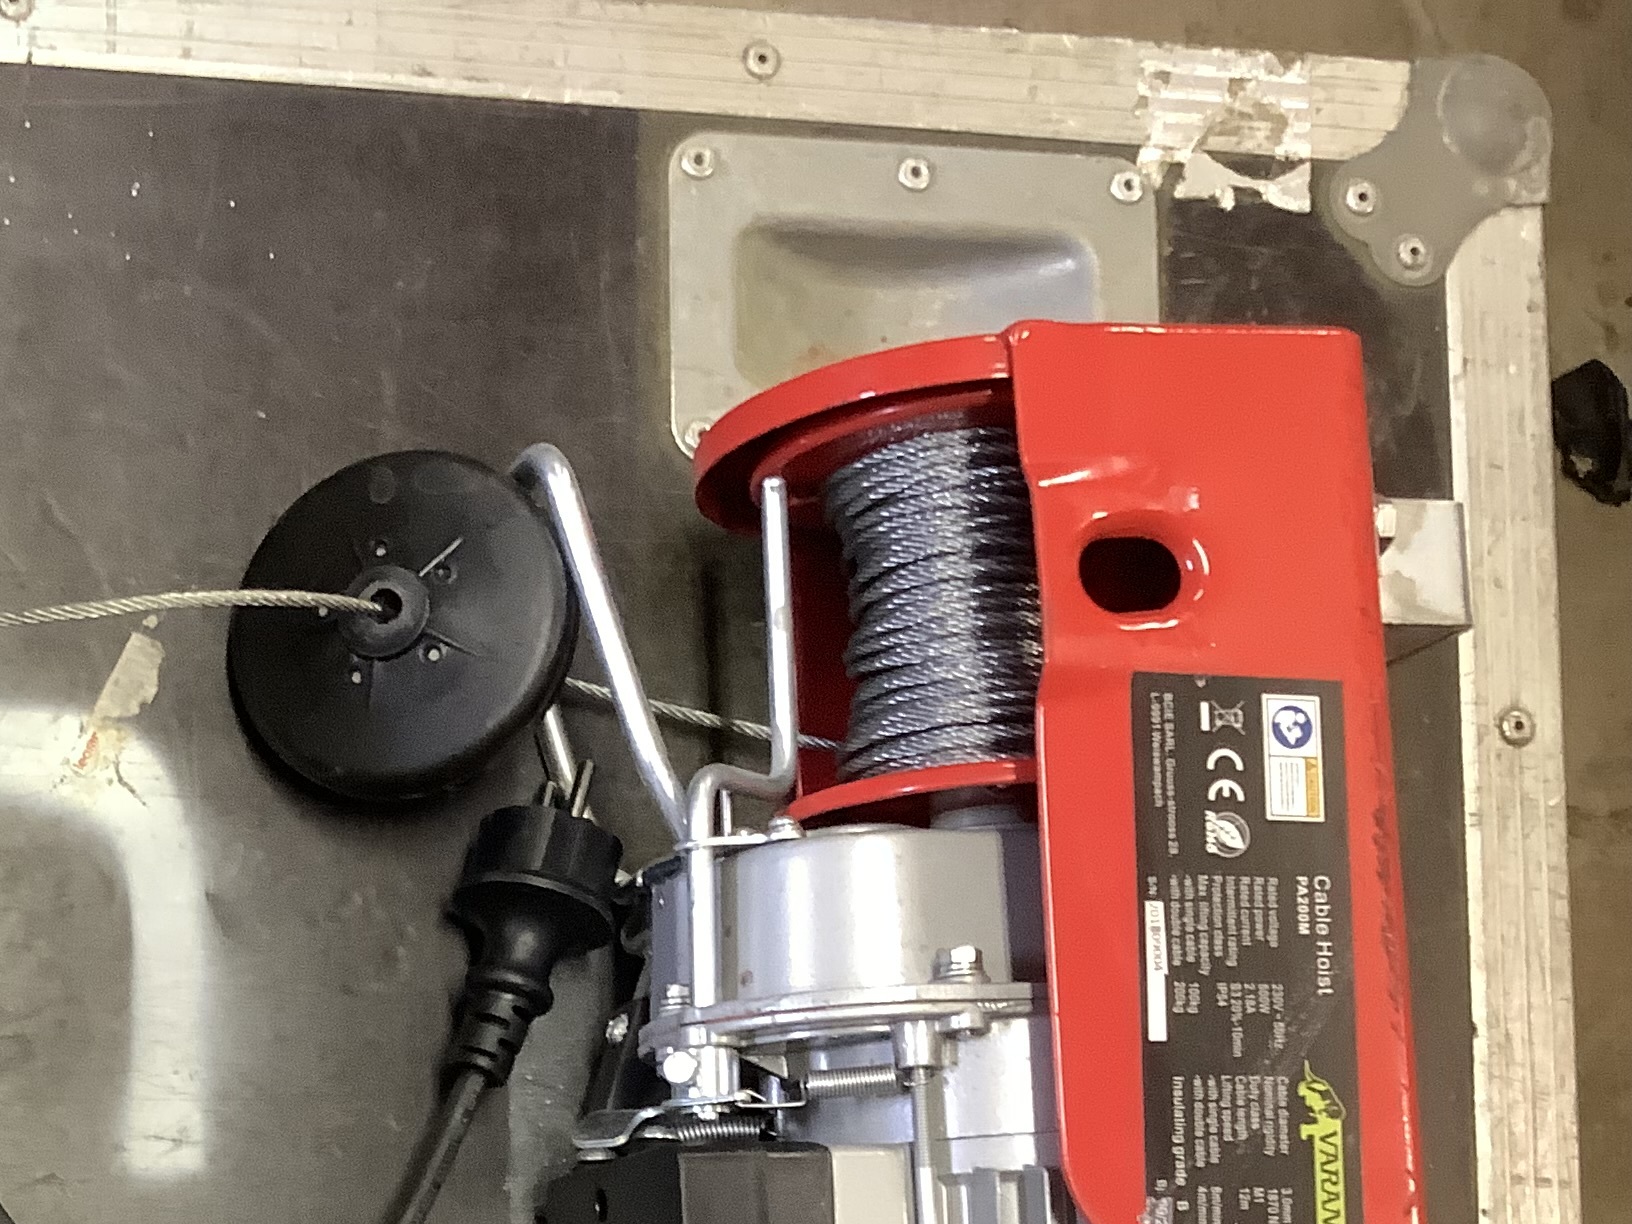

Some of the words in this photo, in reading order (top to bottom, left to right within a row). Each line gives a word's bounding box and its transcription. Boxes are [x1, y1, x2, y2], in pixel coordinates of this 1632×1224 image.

[1206, 748, 1245, 802] CE
[1211, 876, 1222, 927] Protection
[1226, 876, 1237, 934] Intermittent
[1240, 877, 1251, 907] Rated
[1253, 877, 1264, 907] Rated
[1267, 878, 1278, 908] Rated
[1296, 876, 1309, 934] PA200M
[1314, 876, 1332, 935] Cable
[1170, 901, 1181, 936] double
[1183, 902, 1195, 932] single
[1240, 909, 1251, 945] current
[1252, 909, 1264, 941] power
[1266, 910, 1278, 948] voltage
[1172, 938, 1182, 966] cable
[1186, 934, 1196, 962] cable
[1198, 933, 1211, 975] capacity
[1213, 930, 1223, 957] class
[1225, 936, 1237, 966] rating
[1316, 941, 1334, 995] Hoist
[1172, 981, 1186, 1013] 200kg
[1187, 983, 1200, 1013] 100kg
[1271, 984, 1284, 1011] 230V
[1220, 1075, 1232, 1107] Lifting
[1235, 1076, 1246, 1106] Cable
[1248, 1076, 1261, 1100] Duty
[1263, 1077, 1274, 1119] Nominal
[1277, 1077, 1289, 1106] Cable
[1172, 1077, 1187, 1143] Insulating
[1194, 1102, 1205, 1137] double
[1206, 1102, 1218, 1133] single
[1221, 1110, 1234, 1141] speed
[1235, 1108, 1248, 1140] length
[1250, 1102, 1261, 1129] class
[1263, 1121, 1275, 1156] rigidity
[1278, 1109, 1290, 1154] diameter
[1195, 1139, 1206, 1167] cable
[1209, 1135, 1220, 1163] cable
[1172, 1146, 1188, 1186] grade
[1176, 1201, 1189, 1211] B
[1238, 1188, 1249, 1210] 12m
[1253, 1188, 1264, 1202] M1
[1267, 1189, 1278, 1213] 1870
